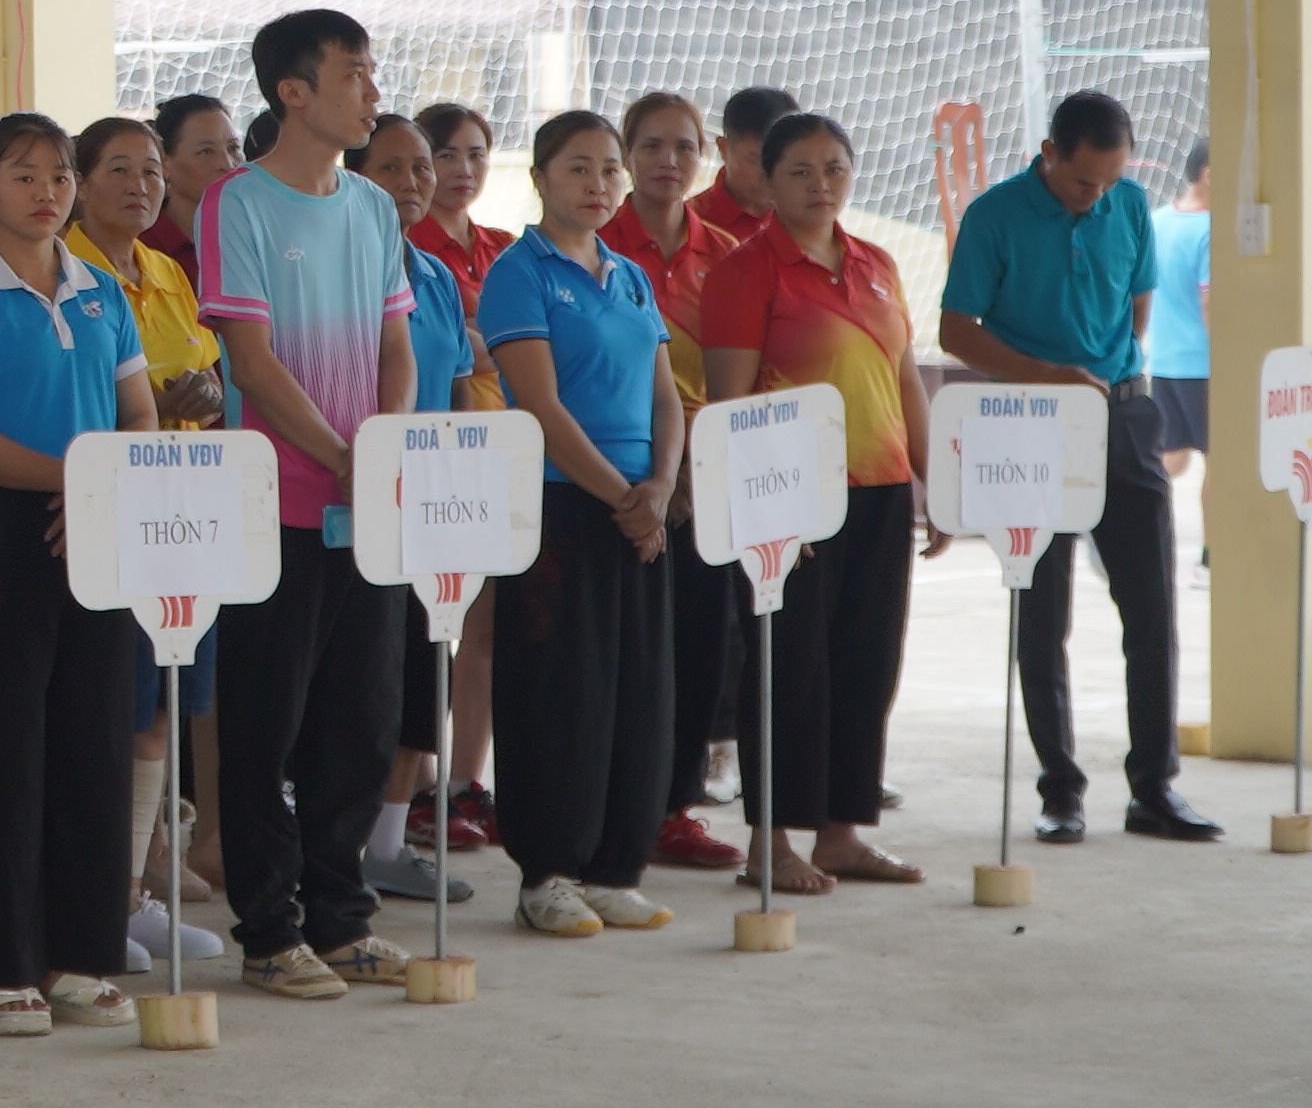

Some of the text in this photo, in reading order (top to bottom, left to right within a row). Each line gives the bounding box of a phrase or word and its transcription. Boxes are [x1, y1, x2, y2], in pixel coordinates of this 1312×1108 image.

[457, 426, 488, 449] VĐV
[129, 439, 223, 468] ĐOÀN VĐV
[792, 467, 801, 490] 9
[1032, 463, 1050, 484] 10
[420, 495, 489, 525] THÔN 8
[139, 513, 219, 546] THÔN 7
